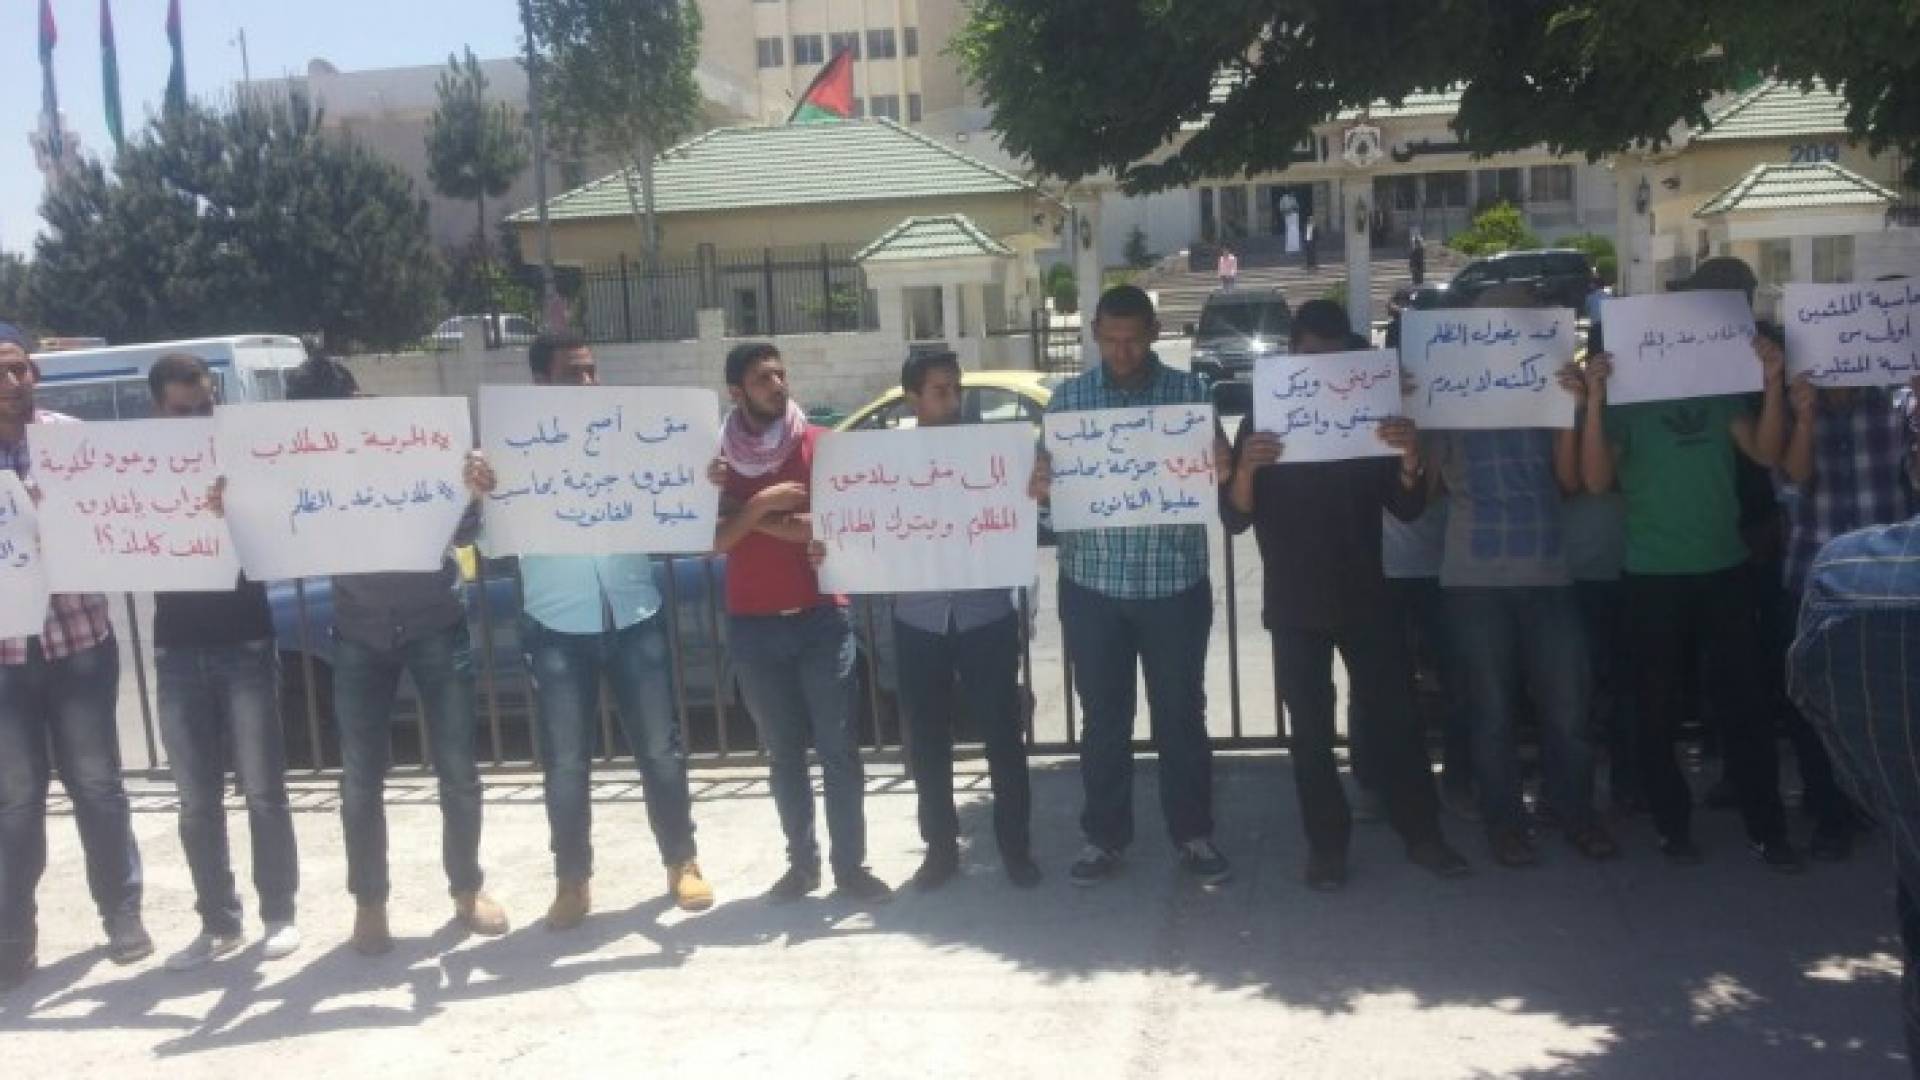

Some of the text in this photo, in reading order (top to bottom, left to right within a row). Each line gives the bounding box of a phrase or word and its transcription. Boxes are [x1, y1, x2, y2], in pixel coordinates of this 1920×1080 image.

[1425, 322, 1468, 362] الظلم
[505, 415, 570, 455] طلب
[633, 415, 689, 443] متى
[1054, 417, 1105, 446] طلب
[1163, 410, 1206, 435] متى
[909, 459, 954, 487] متى
[555, 500, 633, 527] القانون
